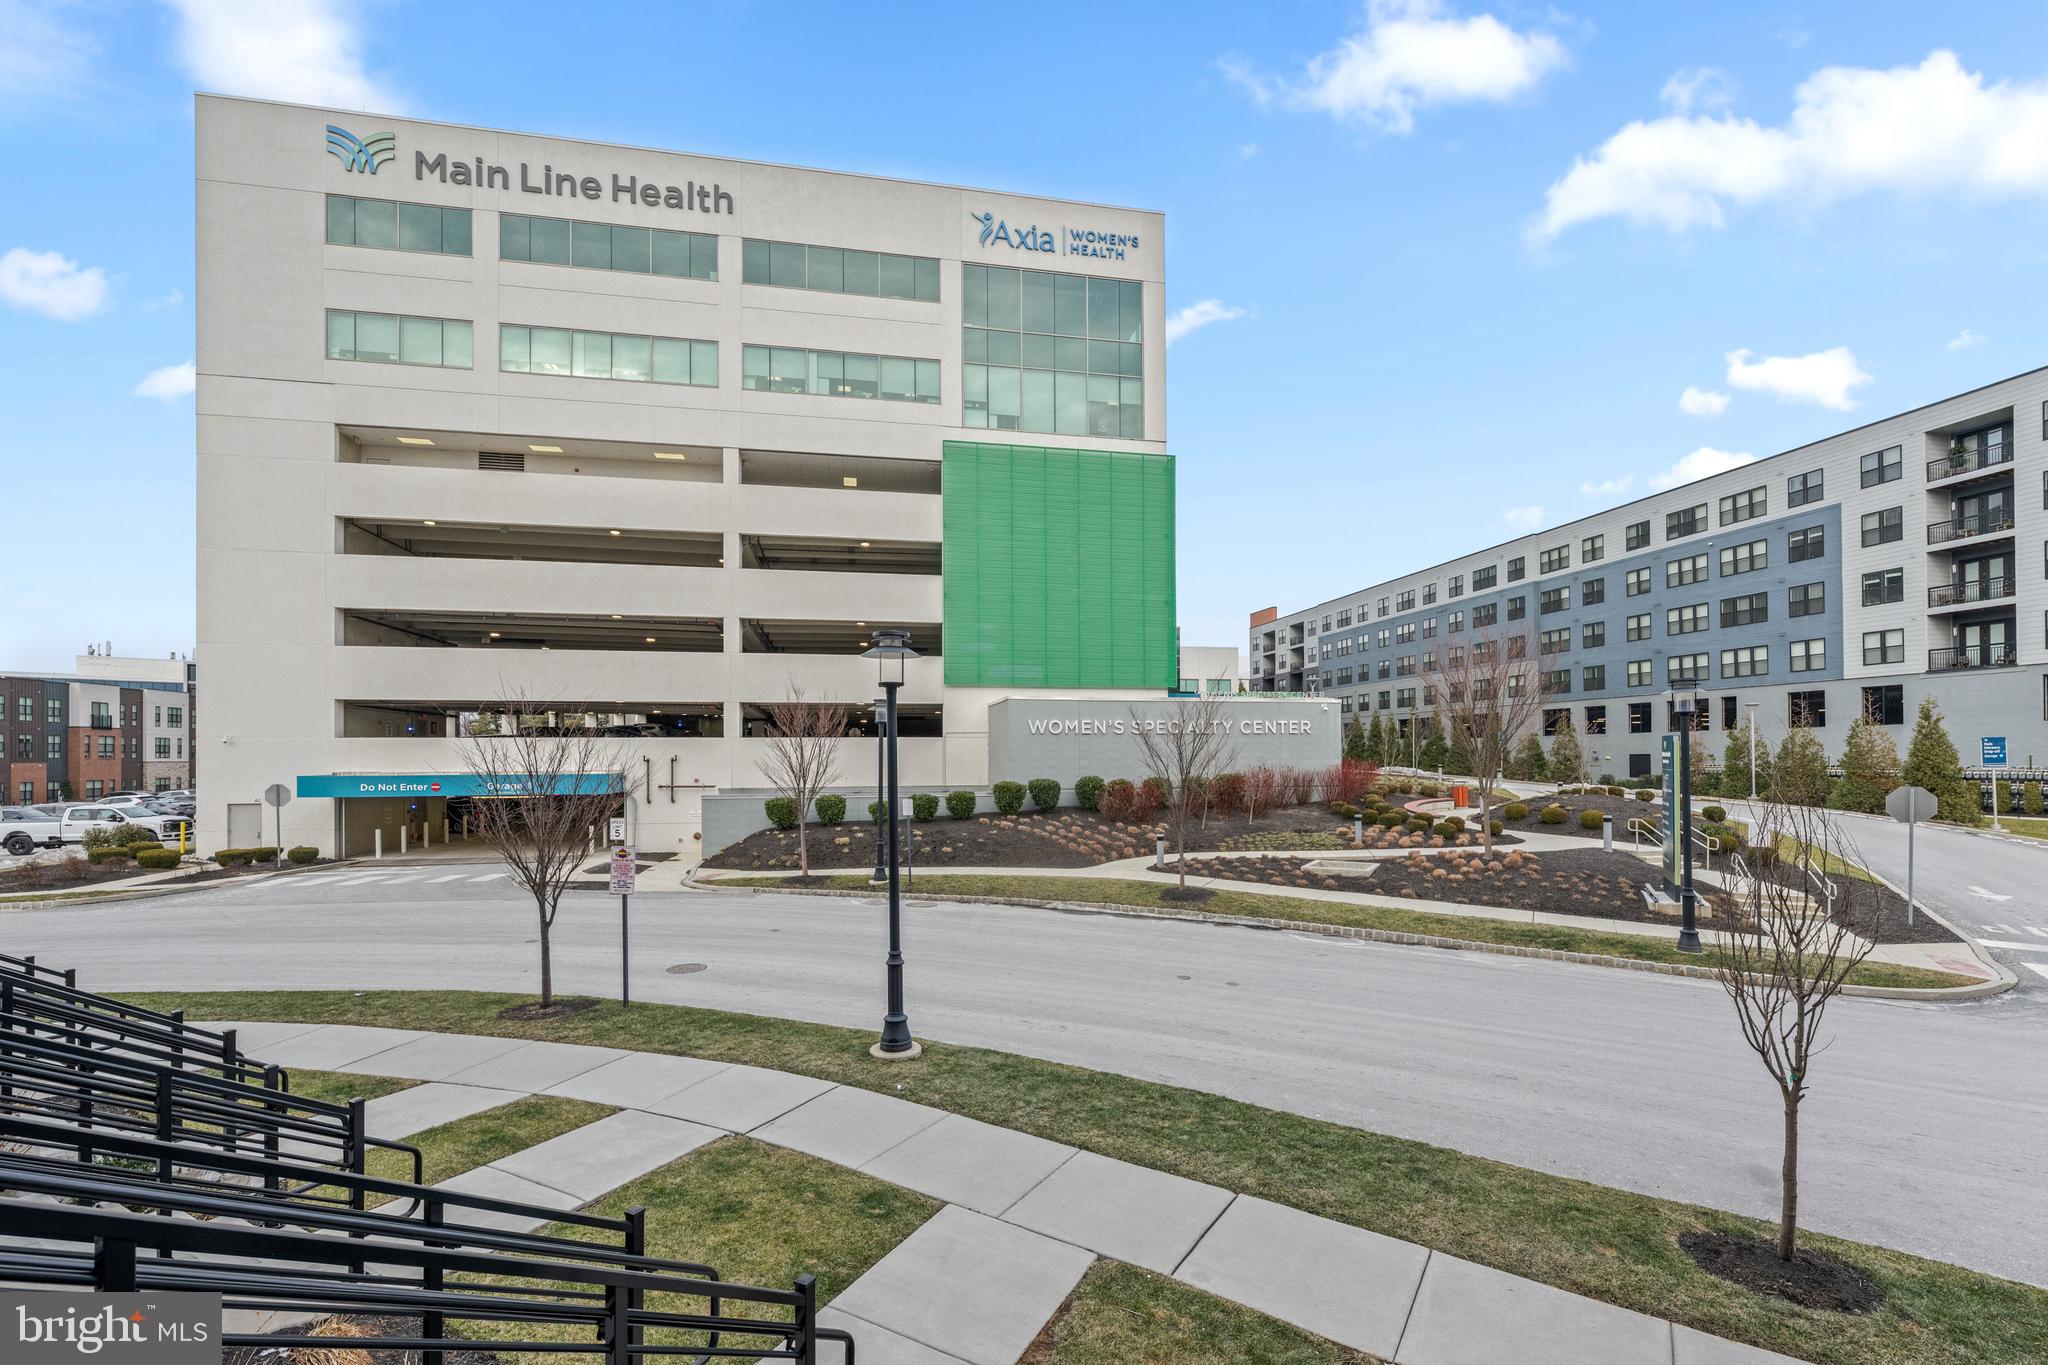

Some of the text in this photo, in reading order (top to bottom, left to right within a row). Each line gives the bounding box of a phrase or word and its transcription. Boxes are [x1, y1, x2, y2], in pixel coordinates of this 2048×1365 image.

[414, 150, 734, 215] Main Line Health
[991, 220, 1056, 253] Axia
[1070, 229, 1140, 248] WOMEN'S
[1070, 243, 1125, 261] HEALTH
[1028, 719, 1125, 735] WOMEN'S
[1240, 719, 1312, 736] CENTER
[360, 782, 428, 792] Do Not Enter
[614, 829, 621, 837] 5
